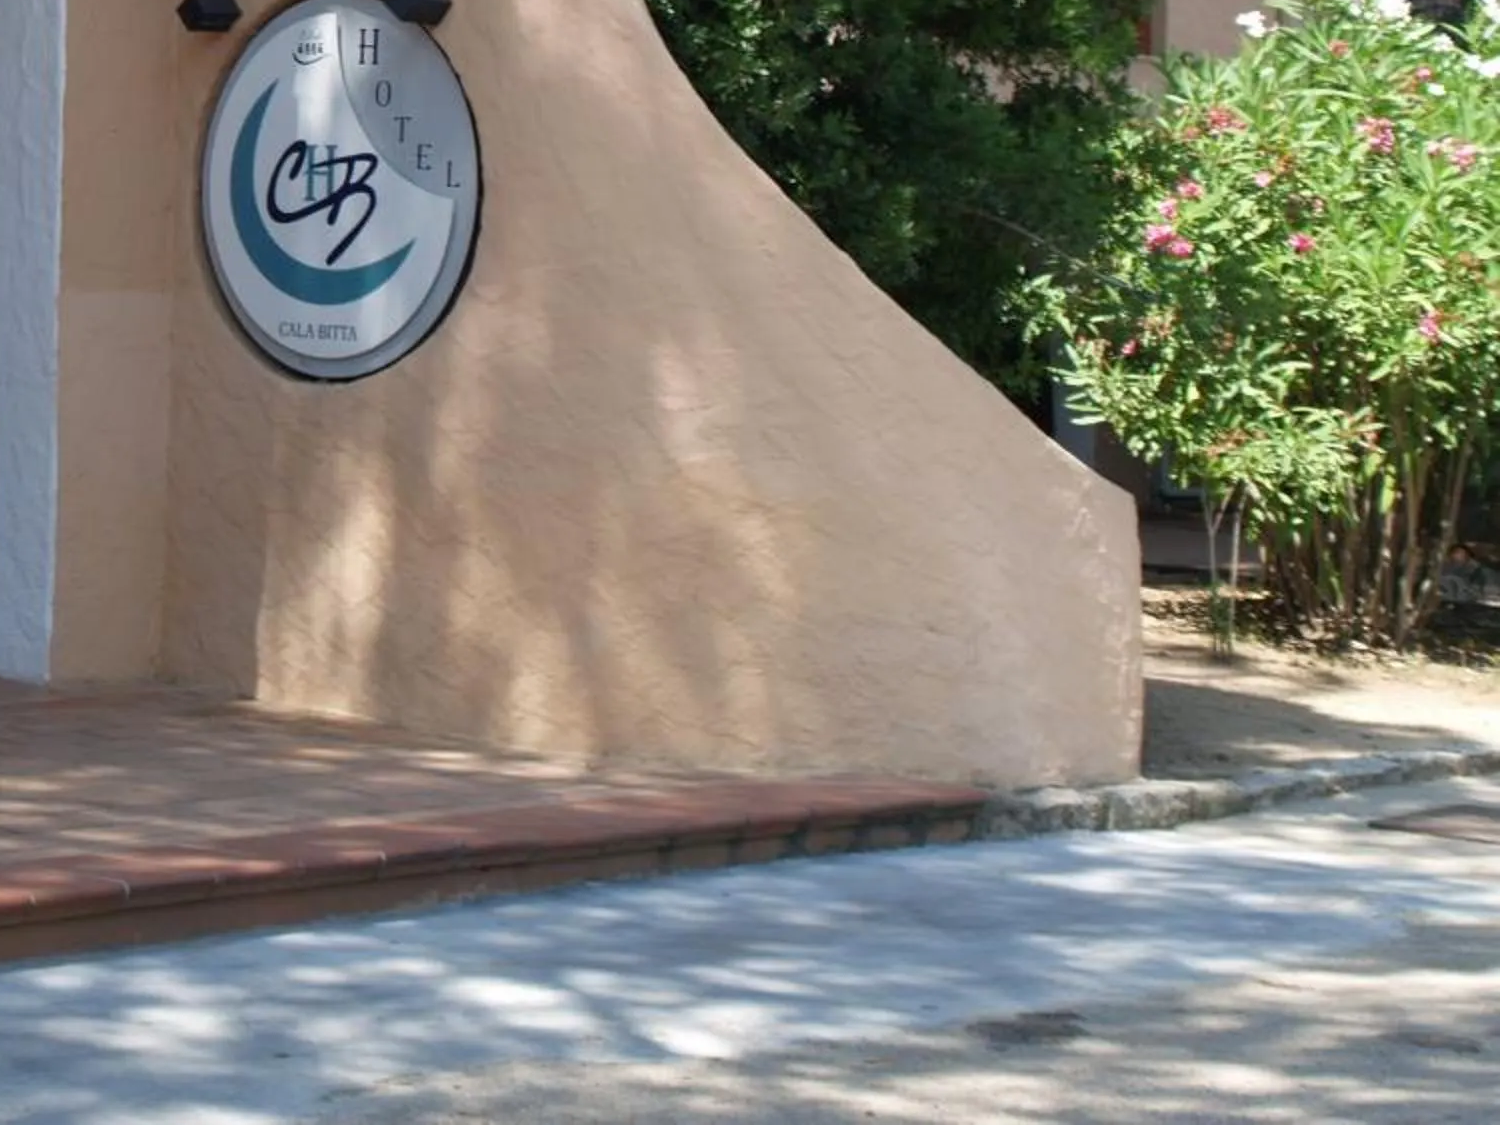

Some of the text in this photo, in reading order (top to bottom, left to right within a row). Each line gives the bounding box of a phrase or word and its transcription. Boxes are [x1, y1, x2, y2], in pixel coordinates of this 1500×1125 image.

[357, 27, 461, 188] HOTEL
[278, 321, 357, 342] CALA BITTA
